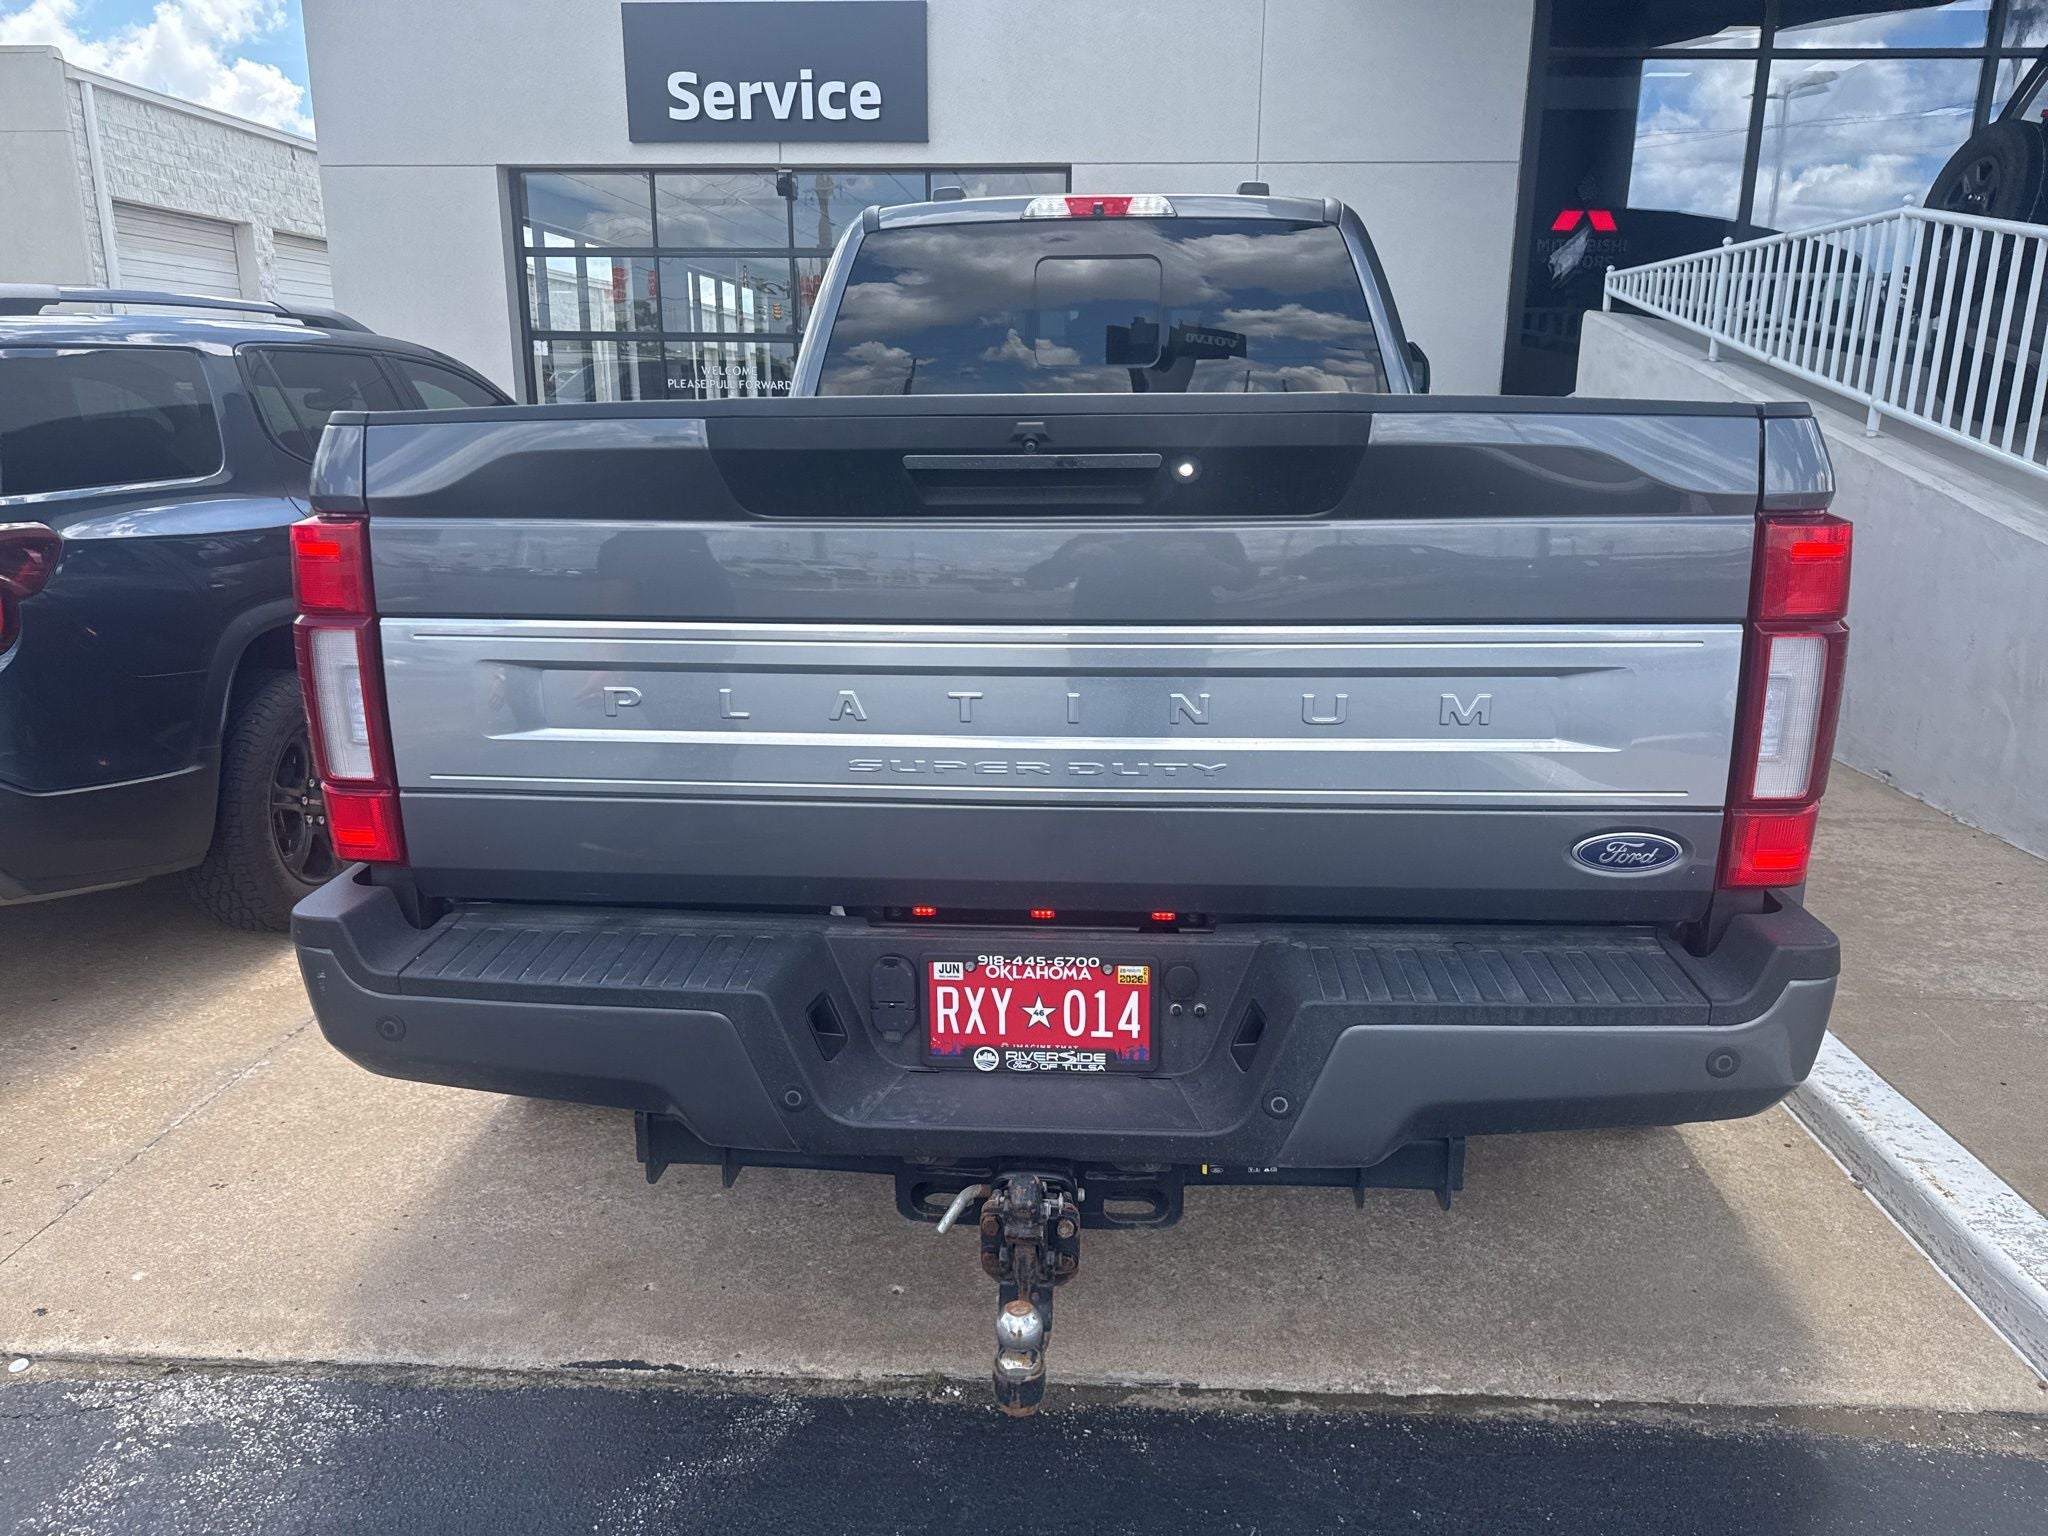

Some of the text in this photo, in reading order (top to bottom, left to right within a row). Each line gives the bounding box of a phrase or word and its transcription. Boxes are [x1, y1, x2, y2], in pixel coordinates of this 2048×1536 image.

[667, 68, 881, 120] Service
[701, 365, 758, 376] WELCOME
[667, 379, 792, 390] PLEASE PULL FORWARD
[603, 686, 1492, 726] PLATINUM
[848, 758, 1227, 777] SUPER DUTY
[1599, 841, 1659, 864] Ford
[977, 955, 1100, 968] 918-445-6700
[939, 963, 960, 974] JUN
[985, 965, 1092, 981] OKLAHOMA
[1119, 974, 1143, 983] 2026
[936, 986, 1141, 1039] RXY 014
[1033, 1009, 1045, 1017] 46
[1005, 1050, 1106, 1063] RIVERSIDE
